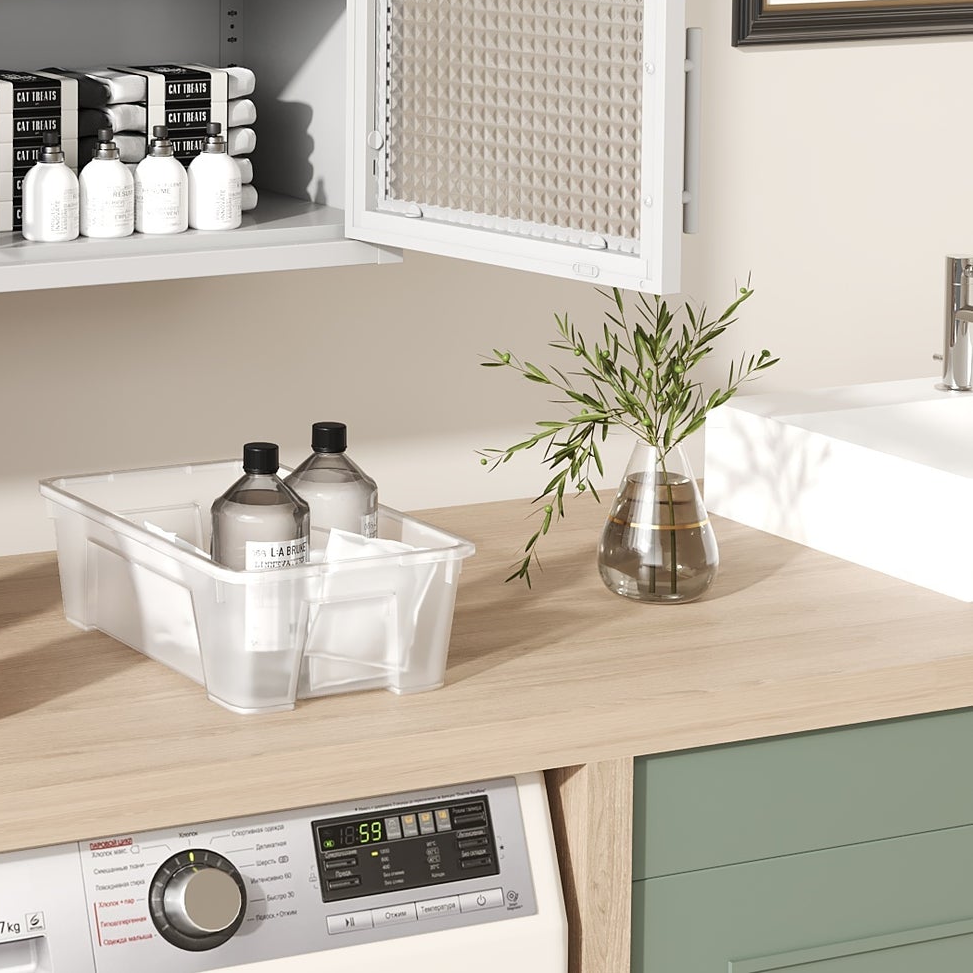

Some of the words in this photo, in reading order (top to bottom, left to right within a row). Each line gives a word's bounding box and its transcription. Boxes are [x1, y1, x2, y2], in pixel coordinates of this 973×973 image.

[168, 84, 181, 94] CAT
[183, 83, 207, 94] TREATS
[16, 92, 29, 102] CAT
[32, 91, 57, 102] TREATS
[168, 113, 181, 123] CAT
[183, 112, 207, 123] TREATS
[16, 121, 29, 132] CAT
[32, 119, 57, 131] TREATS
[172, 141, 180, 151] AT
[183, 140, 202, 151] TREAT
[16, 150, 29, 161] CAT
[232, 828, 264, 837] Спортивная
[256, 841, 287, 851] Деликатная
[92, 849, 112, 858] Хлопок
[256, 859, 277, 867] Шерсть
[250, 875, 283, 885] Интенсивно
[267, 893, 287, 901] Быстро
[98, 900, 119, 908] Хлопок
[124, 898, 135, 906] пар
[421, 903, 456, 913] Температура
[385, 911, 407, 920] Отжим
[103, 937, 127, 946] Одежда
[128, 934, 153, 942] малыша
